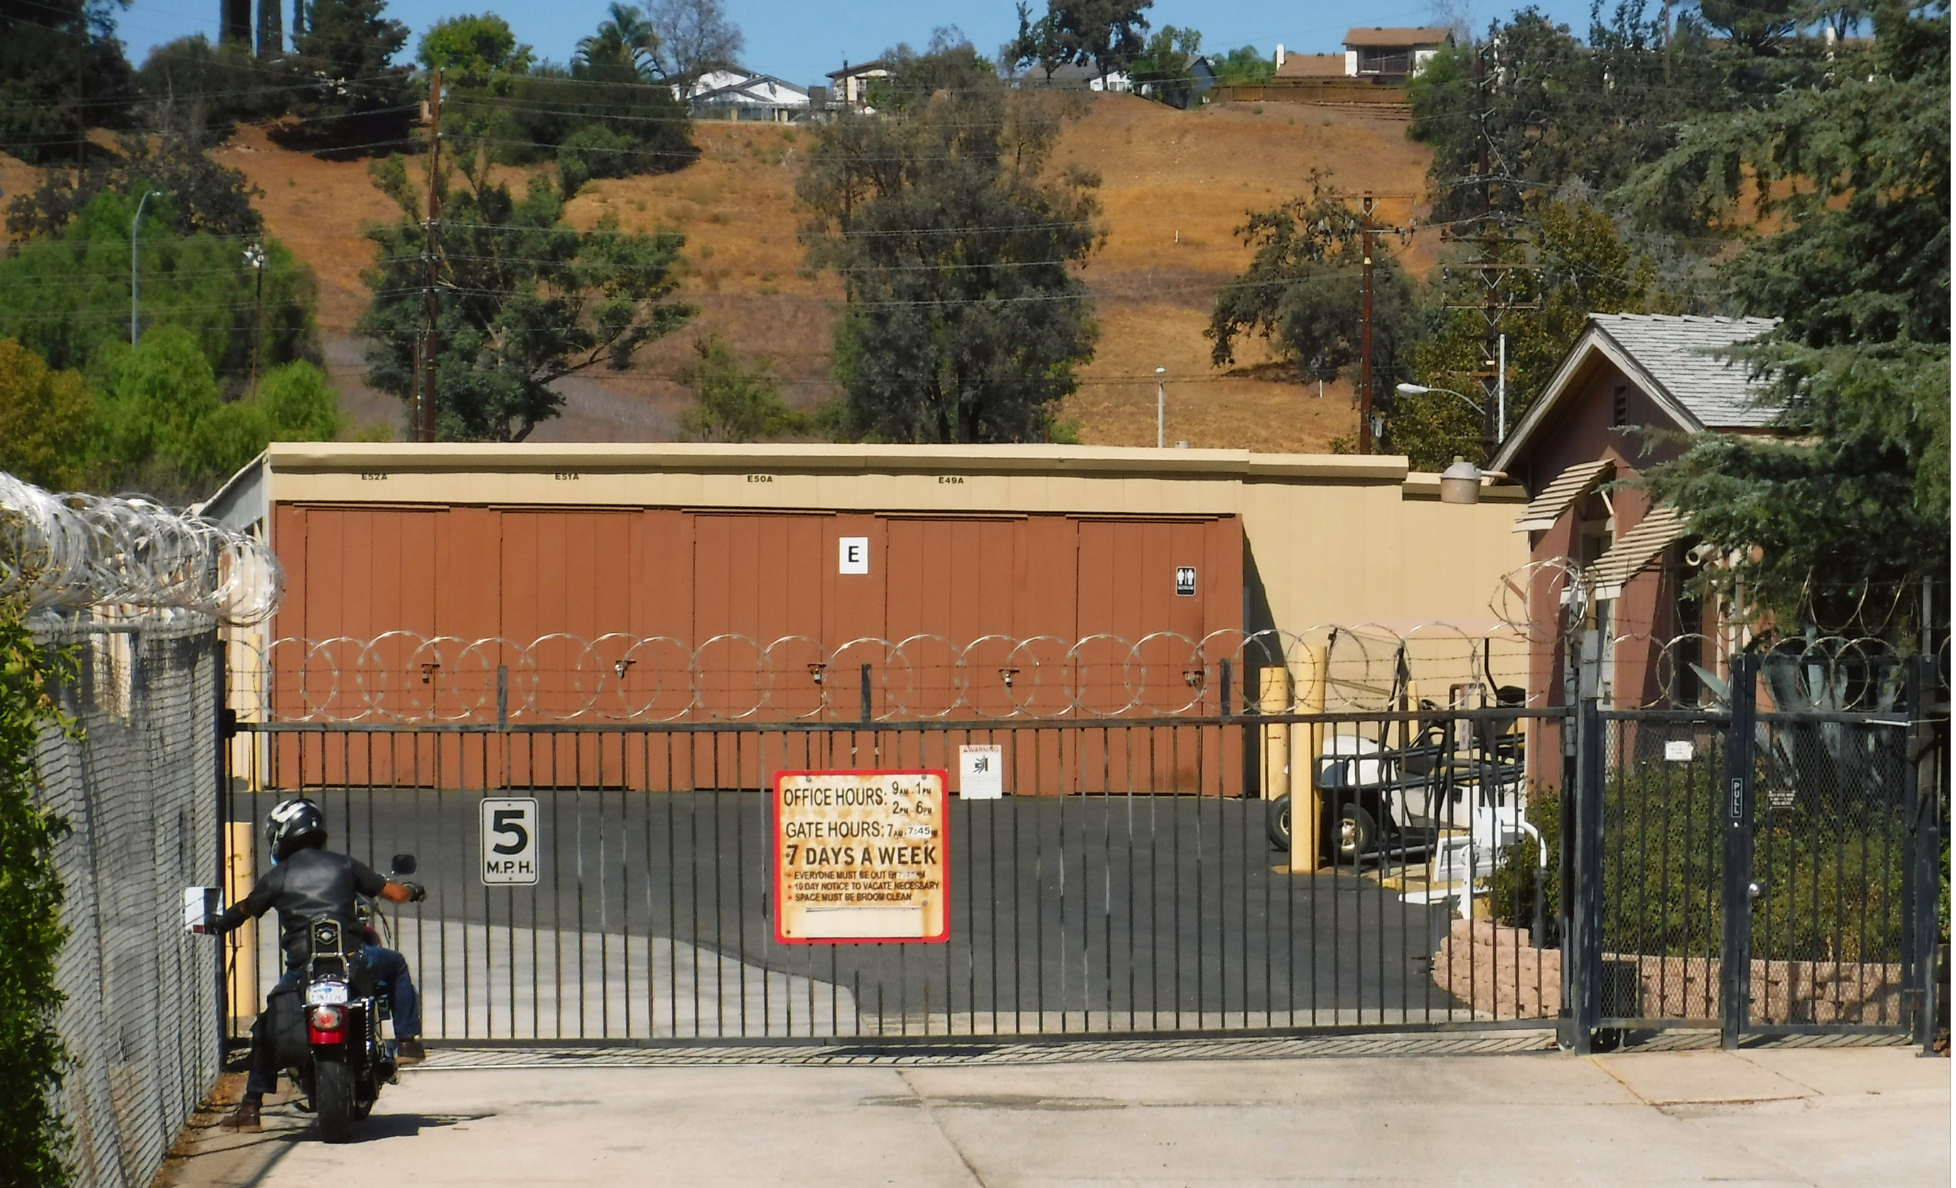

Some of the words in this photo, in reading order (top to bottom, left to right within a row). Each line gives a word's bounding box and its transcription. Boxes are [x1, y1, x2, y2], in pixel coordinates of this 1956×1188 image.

[361, 473, 388, 481] E52A
[555, 473, 580, 481] E51A
[747, 475, 774, 483] E50A
[848, 545, 859, 563] E
[783, 788, 832, 806] OFFICE
[836, 788, 888, 806] HOURS:
[492, 810, 528, 855] 5
[785, 822, 823, 838] GATE
[828, 821, 885, 838] HOURS:
[908, 826, 931, 836] 7:45
[786, 844, 799, 866] 7
[806, 846, 855, 866] DAYS
[861, 847, 873, 865] A
[878, 845, 937, 865] WEEK
[794, 871, 835, 879] EVERYONE
[836, 871, 857, 879] MUST
[859, 871, 869, 879] BE
[870, 870, 886, 879] OUT
[795, 882, 804, 890] 10
[804, 882, 819, 890] DAY
[821, 882, 850, 890] NOTICE
[851, 882, 862, 890] TO
[862, 882, 893, 890] VACATE
[893, 881, 939, 890] NECESSARY
[795, 893, 821, 902] SPACE
[822, 893, 843, 901] MUST
[844, 893, 855, 902] BE
[856, 892, 885, 901] BROOM
[886, 892, 912, 901] CLEAN
